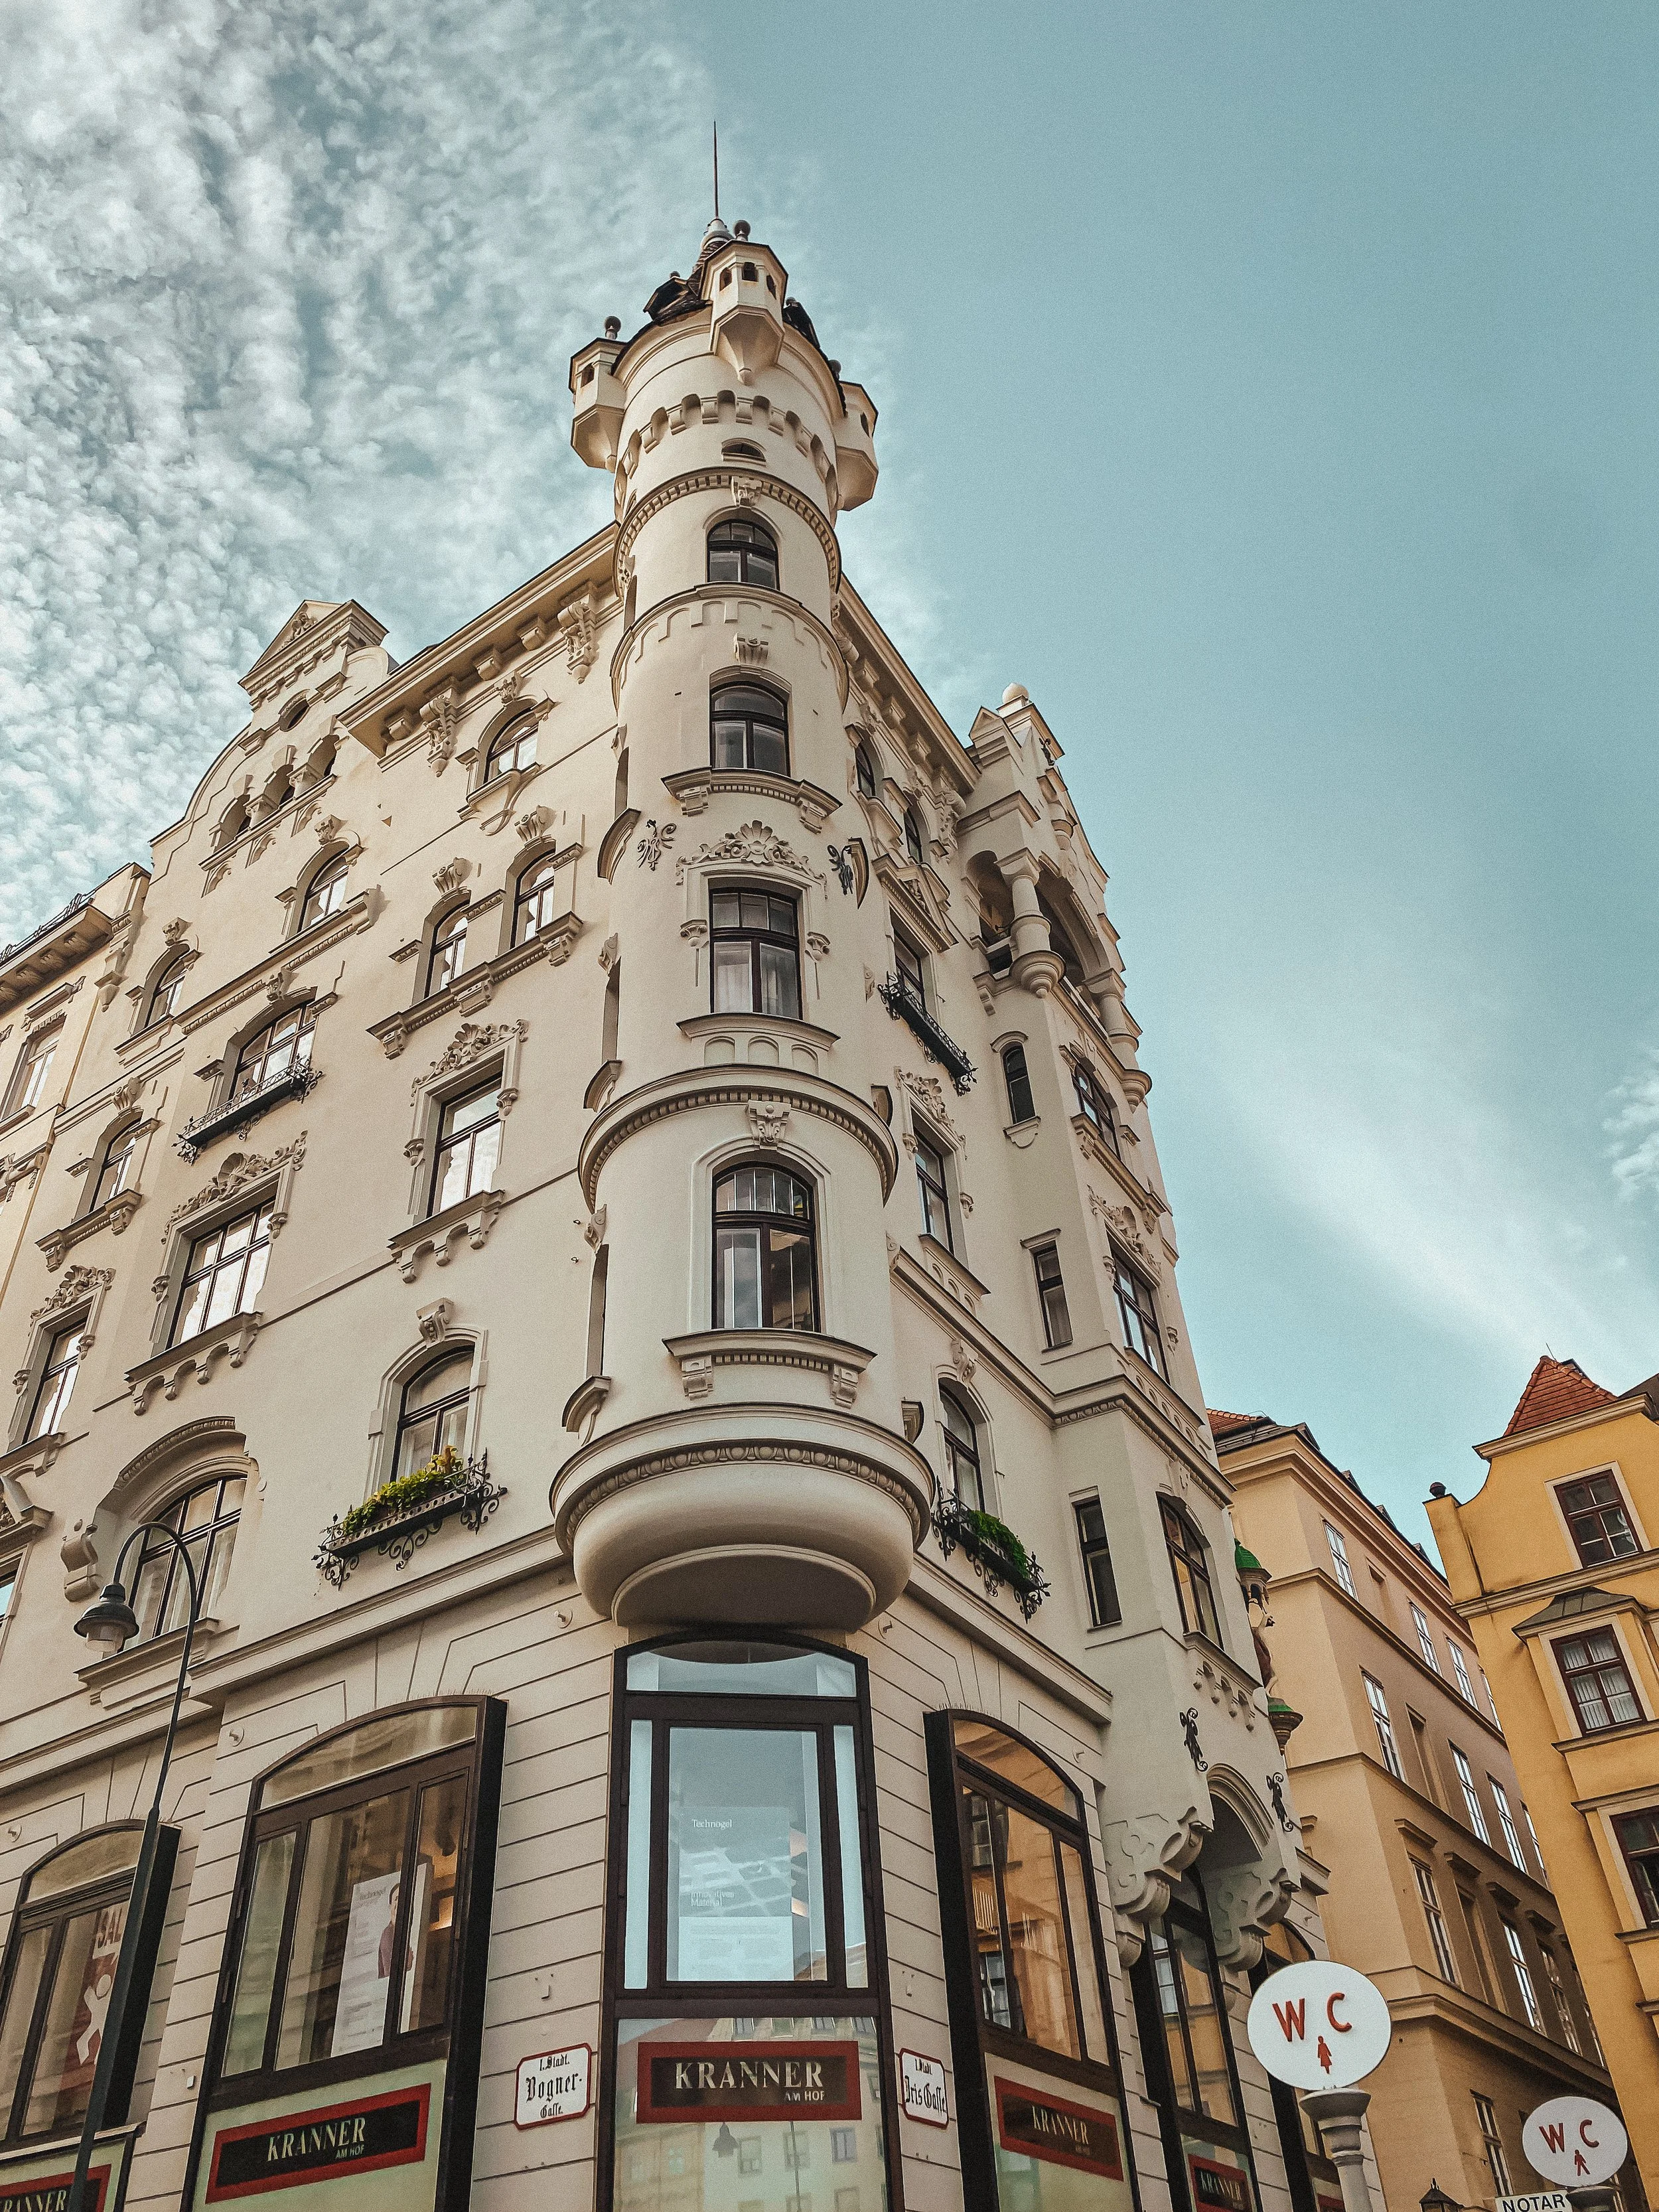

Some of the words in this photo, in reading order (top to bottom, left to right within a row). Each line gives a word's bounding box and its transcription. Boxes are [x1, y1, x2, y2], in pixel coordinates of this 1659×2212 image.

[692, 1819, 732, 1830] Technogel
[96, 1907, 123, 1949] SAL
[676, 2061, 824, 2089] KRANNER
[785, 2091, 800, 2101] AM
[804, 2091, 825, 2101] HOF
[1032, 2105, 1089, 2145] KRANNER
[267, 2117, 366, 2162] KRANNER
[335, 2148, 347, 2159] AM
[350, 2144, 364, 2156] HOF
[1200, 2171, 1242, 2201] KRANNER
[1502, 2193, 1566, 2212] NOTAR
